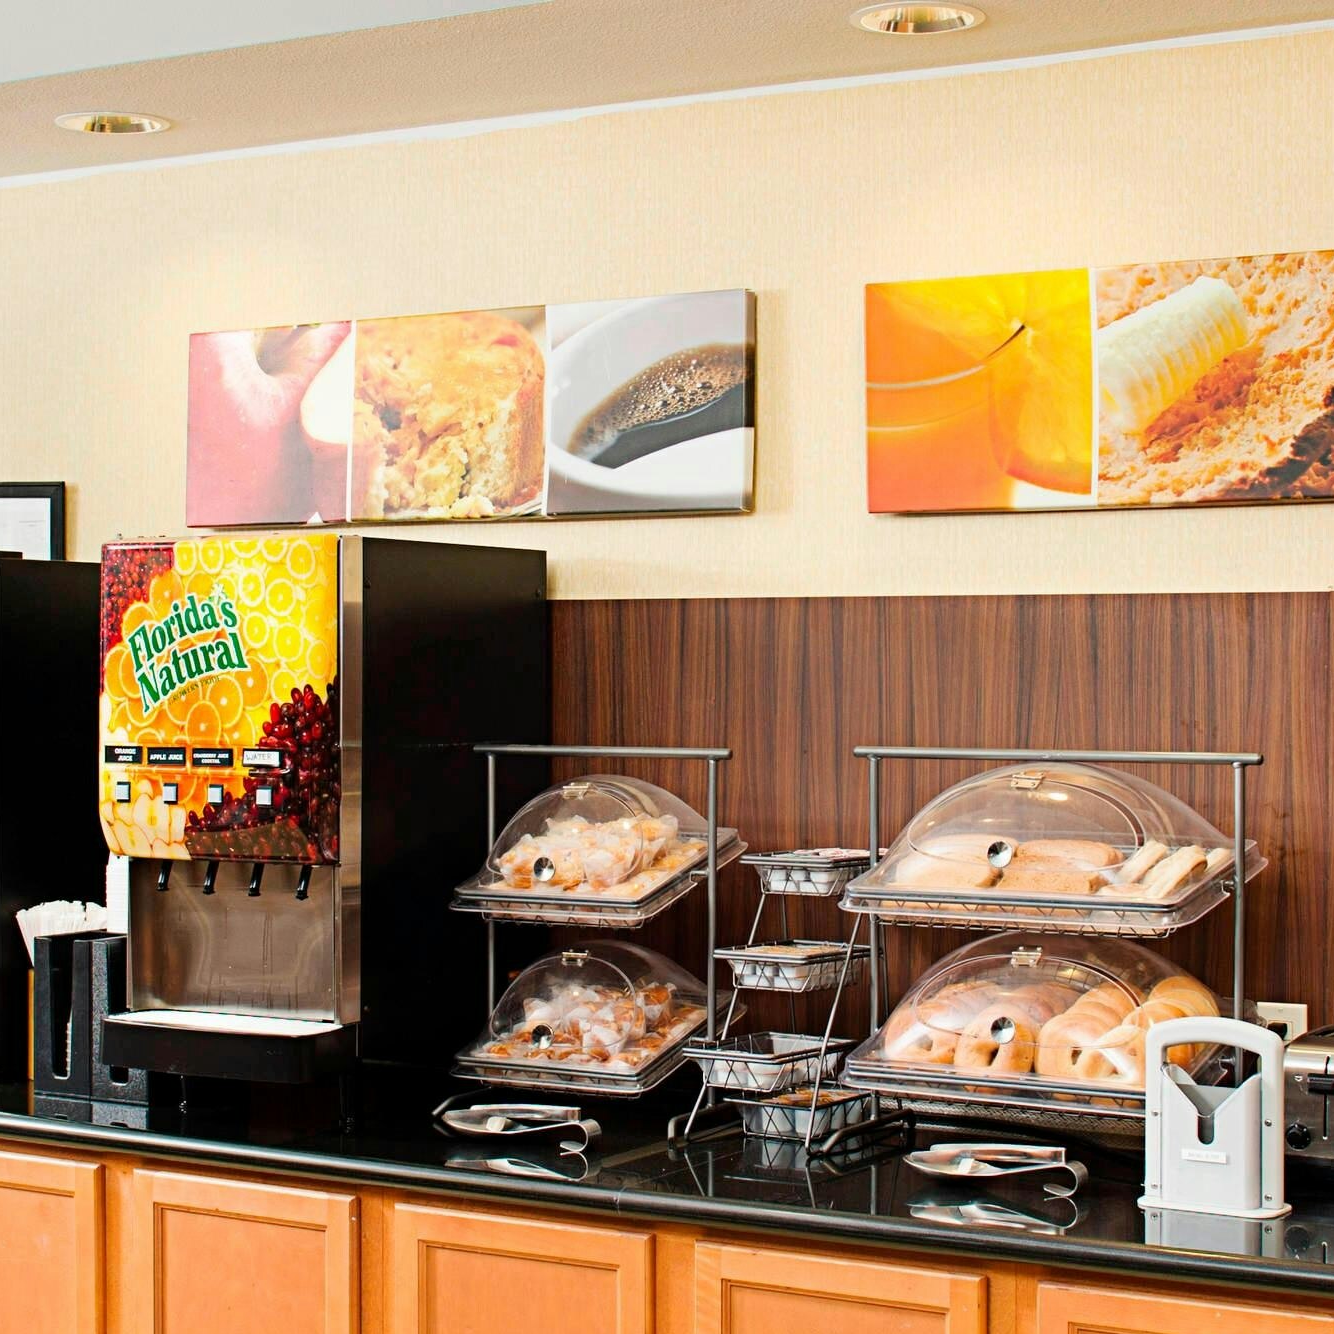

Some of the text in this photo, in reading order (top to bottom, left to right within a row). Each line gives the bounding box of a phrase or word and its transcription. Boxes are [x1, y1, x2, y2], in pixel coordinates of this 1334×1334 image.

[128, 595, 238, 672] Florida's
[138, 632, 248, 713] Natural
[114, 747, 136, 755] ORANGE
[149, 753, 183, 761] APPLE JUICE
[246, 752, 272, 761] WATER
